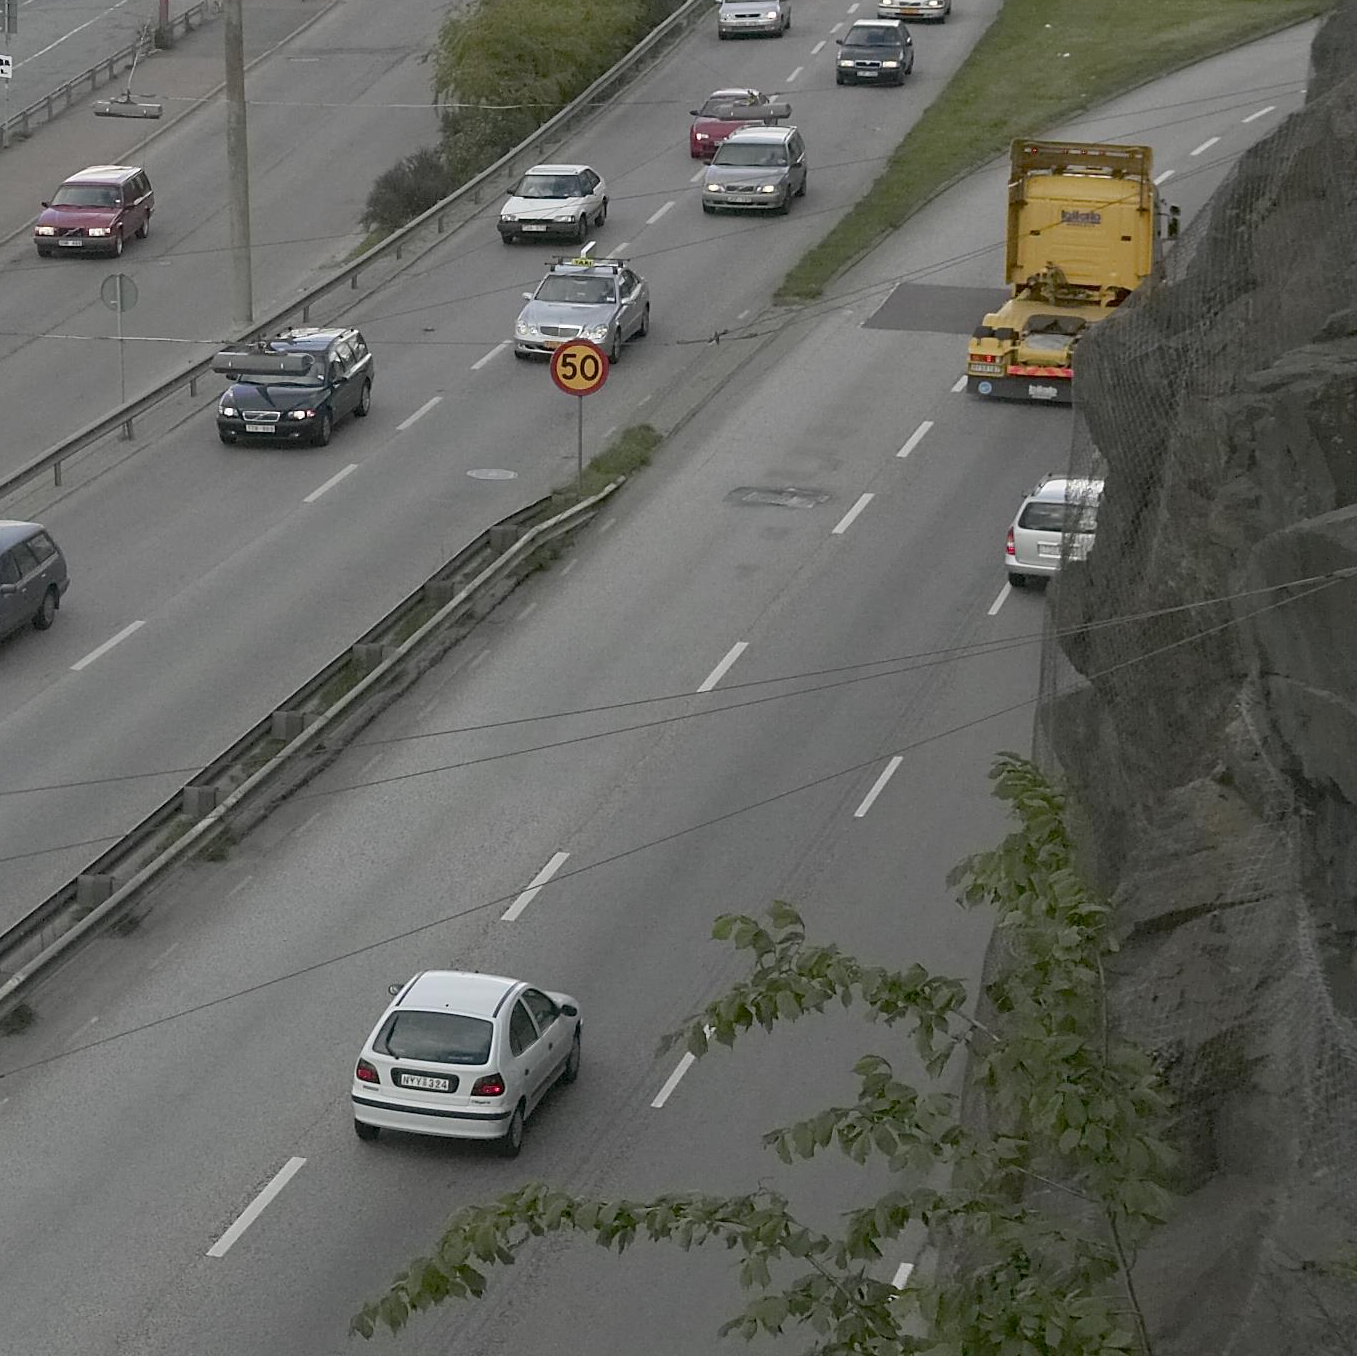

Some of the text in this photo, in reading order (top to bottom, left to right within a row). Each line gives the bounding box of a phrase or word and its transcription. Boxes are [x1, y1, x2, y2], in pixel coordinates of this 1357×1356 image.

[561, 353, 600, 382] 50
[402, 1074, 448, 1090] NYY 324
